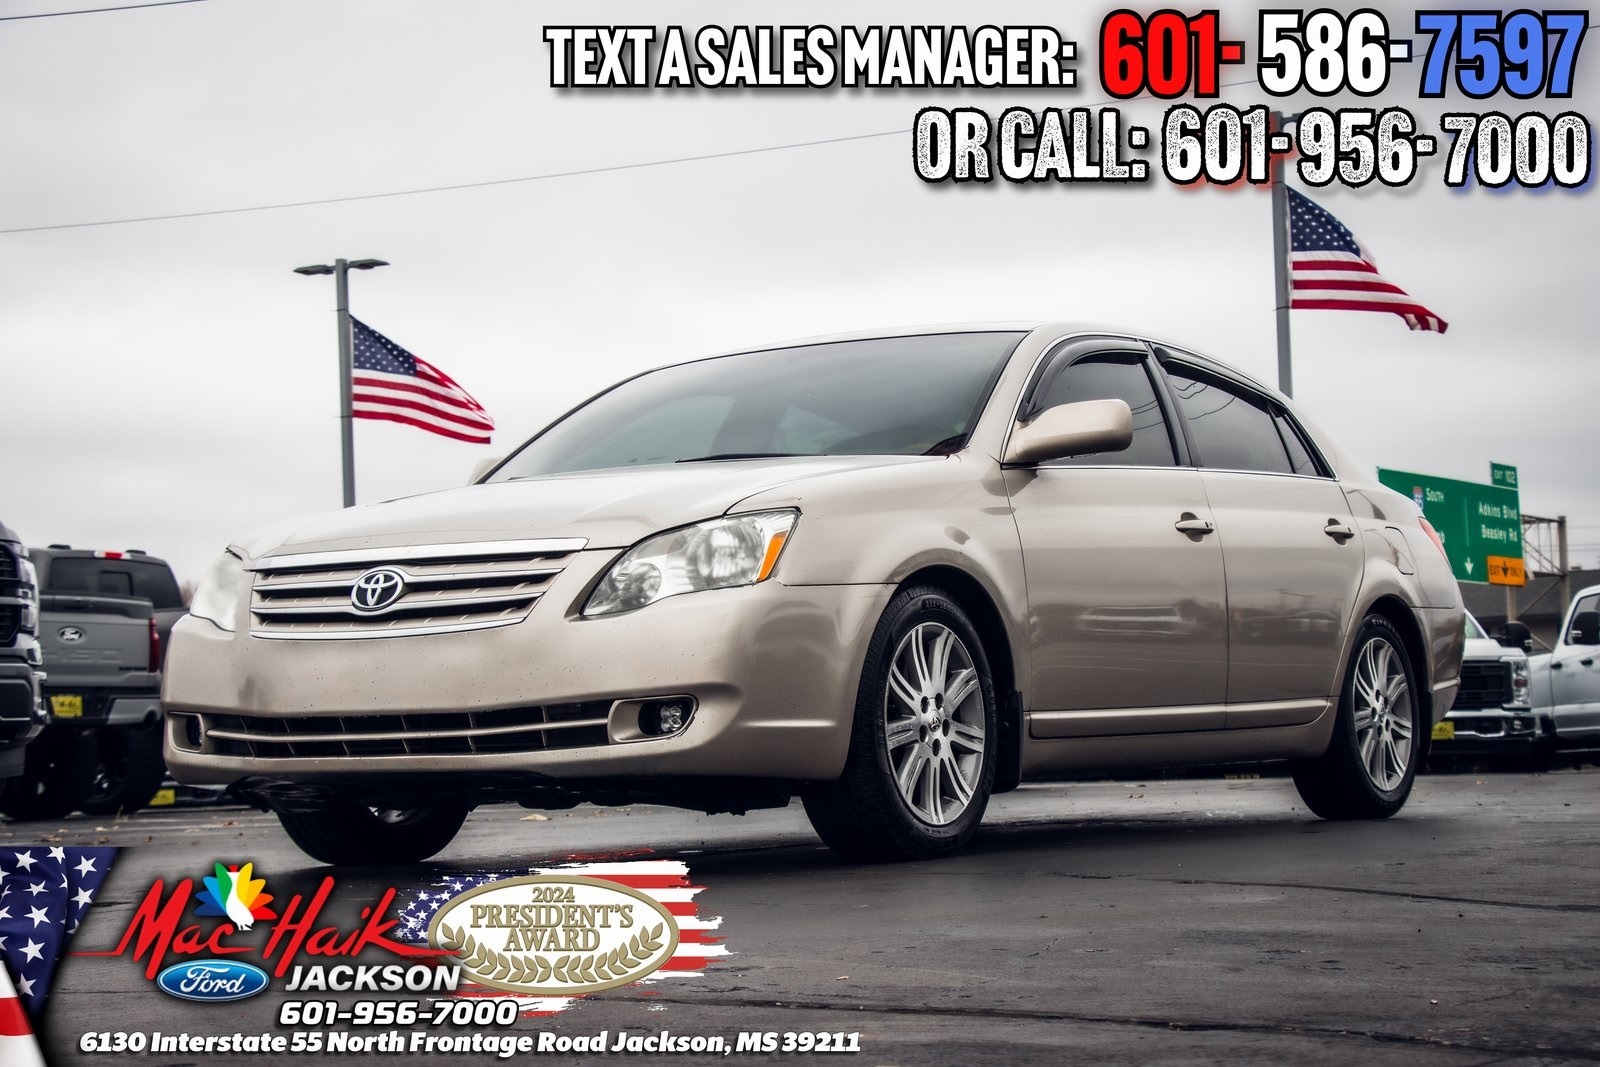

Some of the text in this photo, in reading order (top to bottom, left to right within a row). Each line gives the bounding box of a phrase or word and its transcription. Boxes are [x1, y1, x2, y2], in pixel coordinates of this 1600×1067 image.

[1505, 470, 1516, 484] 102
[1478, 502, 1518, 520] Adkins Blvd
[1481, 524, 1518, 543] Beasley Rd
[1489, 564, 1523, 578] EXIT ONLY
